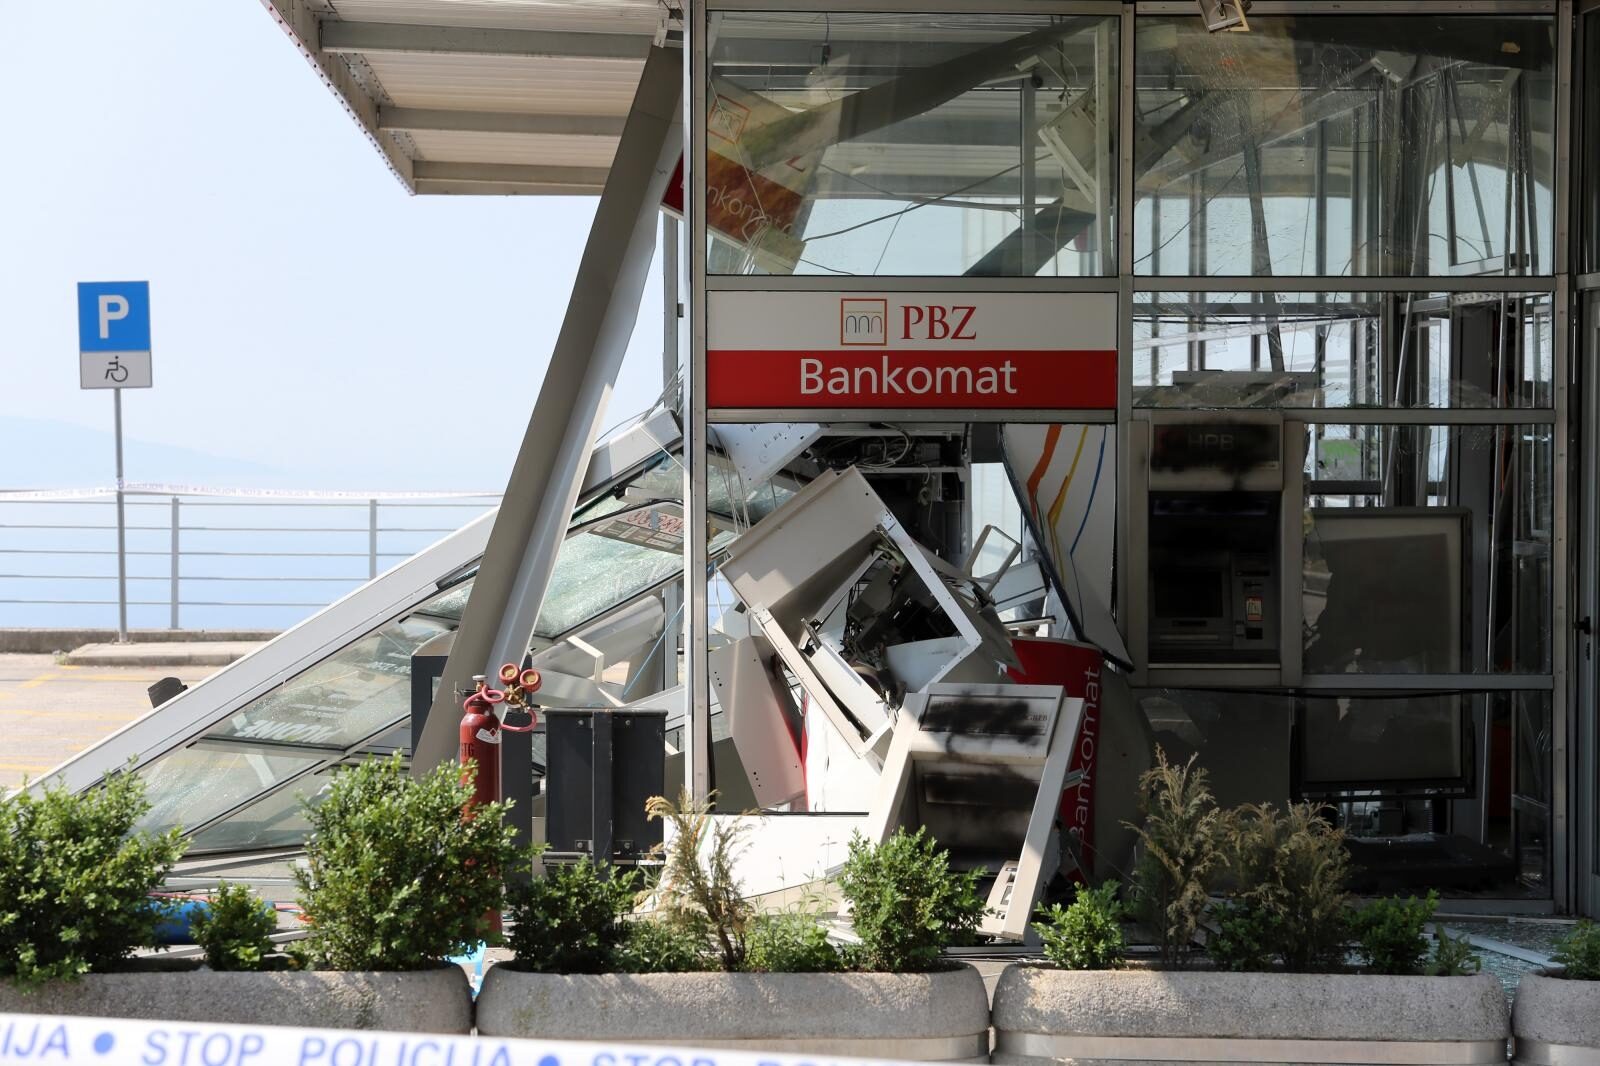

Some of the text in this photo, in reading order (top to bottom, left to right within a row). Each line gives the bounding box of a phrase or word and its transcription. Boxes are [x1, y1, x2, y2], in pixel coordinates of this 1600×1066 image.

[98, 294, 129, 339] P
[900, 305, 977, 340] PBZ
[800, 355, 1017, 395] Bankomat
[141, 1029, 266, 1066] STOP
